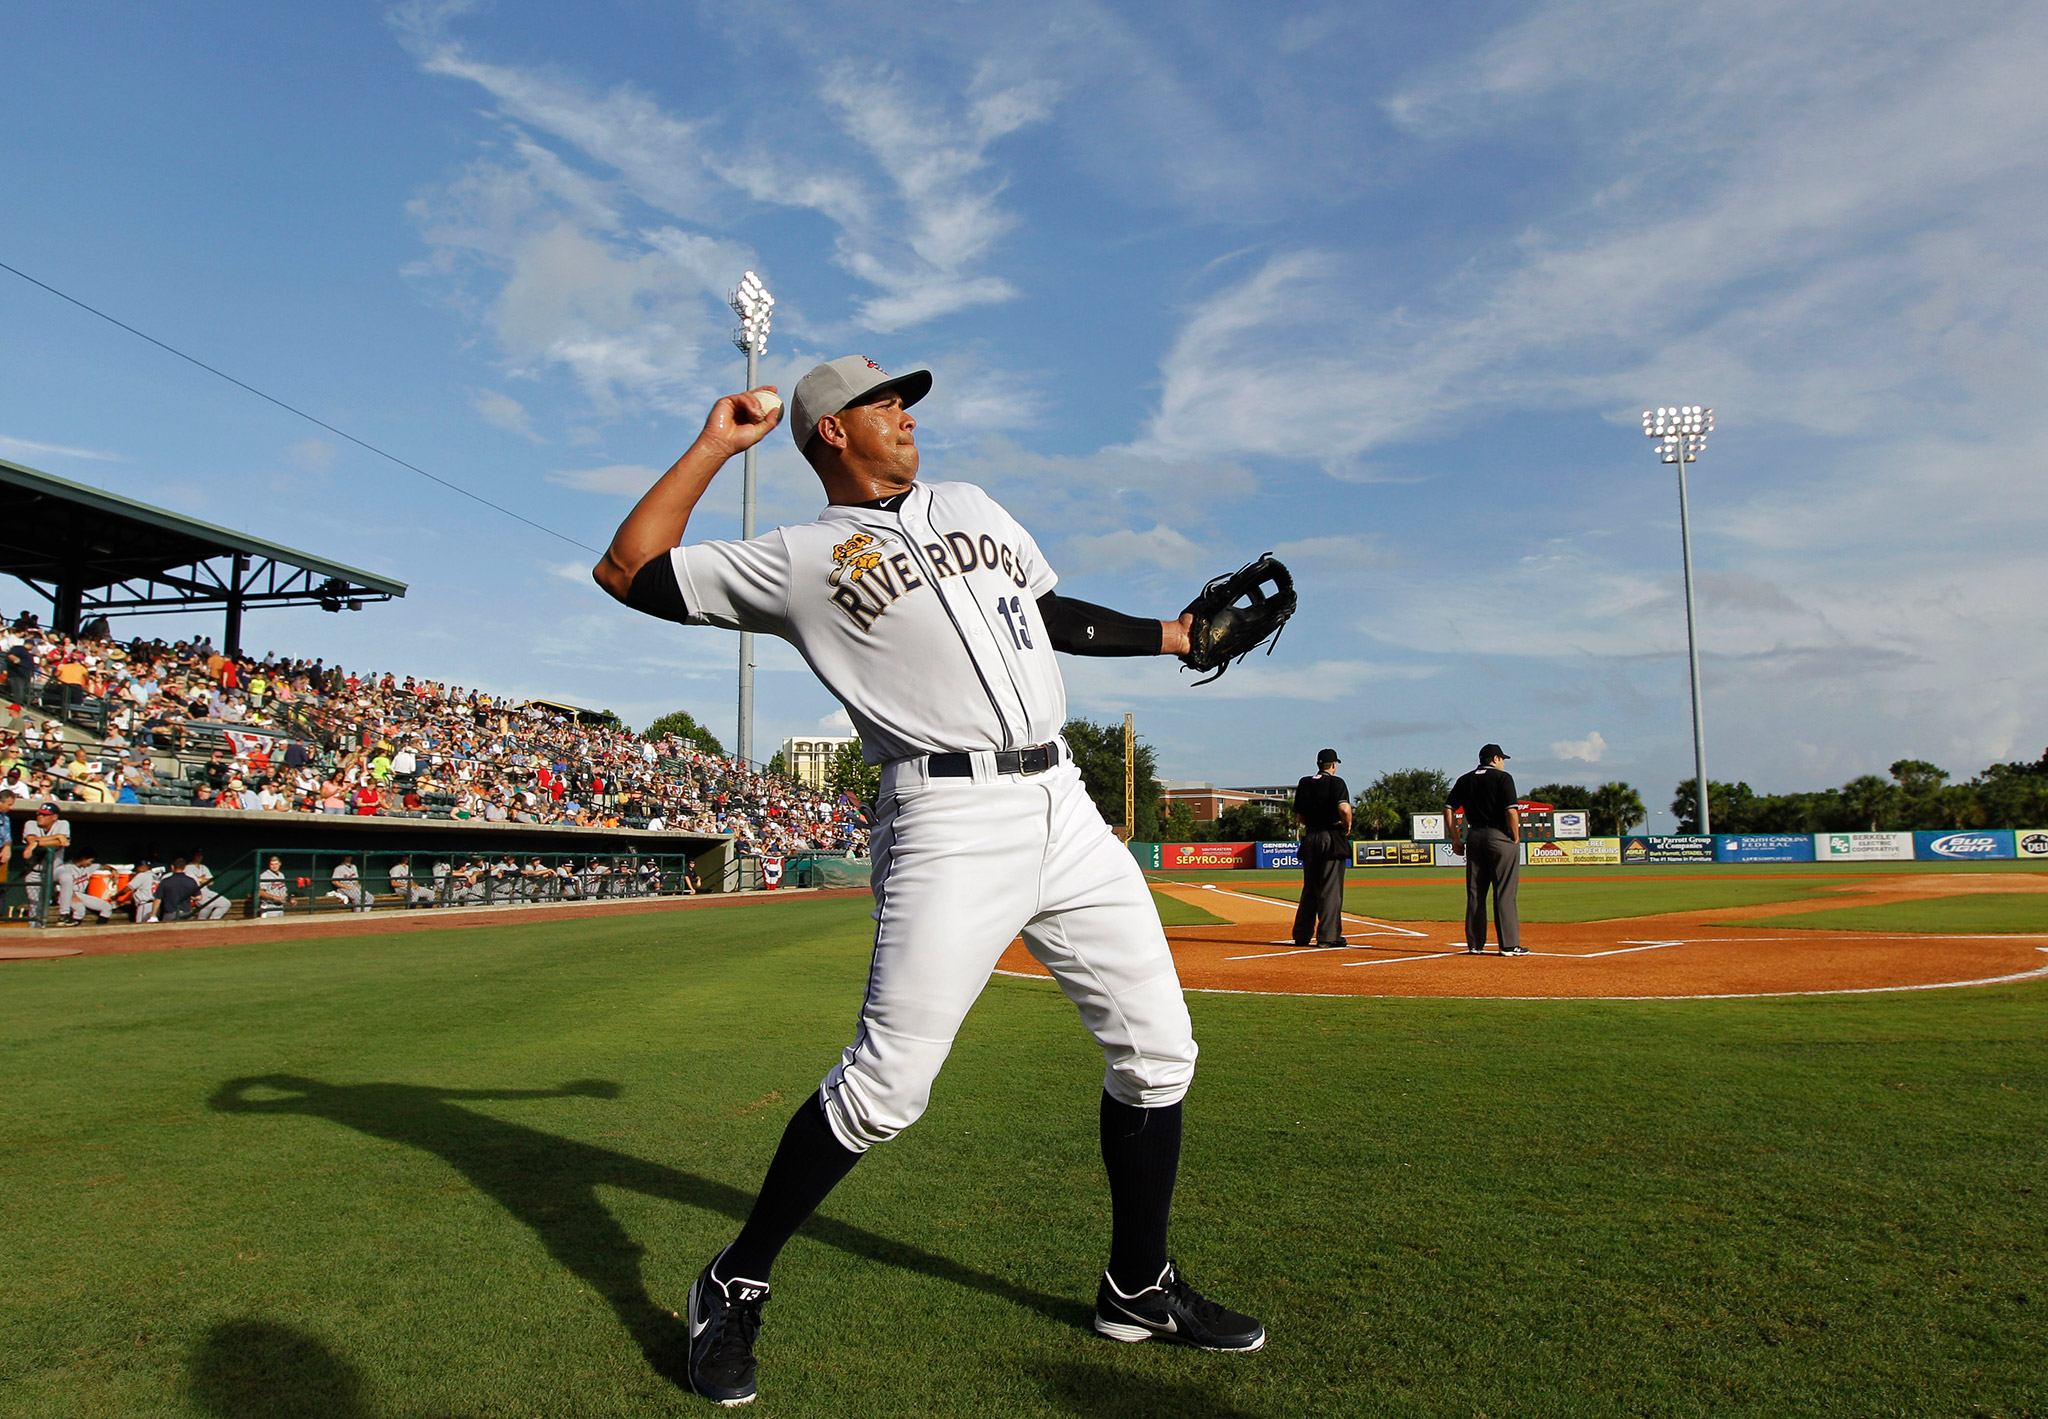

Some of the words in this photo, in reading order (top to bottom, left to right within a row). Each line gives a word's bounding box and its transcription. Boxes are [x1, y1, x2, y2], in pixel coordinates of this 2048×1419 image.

[997, 596, 1034, 650] 13
[1831, 837, 1849, 852] BEC
[1176, 856, 1243, 864] SEPYRO.com
[739, 1287, 761, 1300] 13
